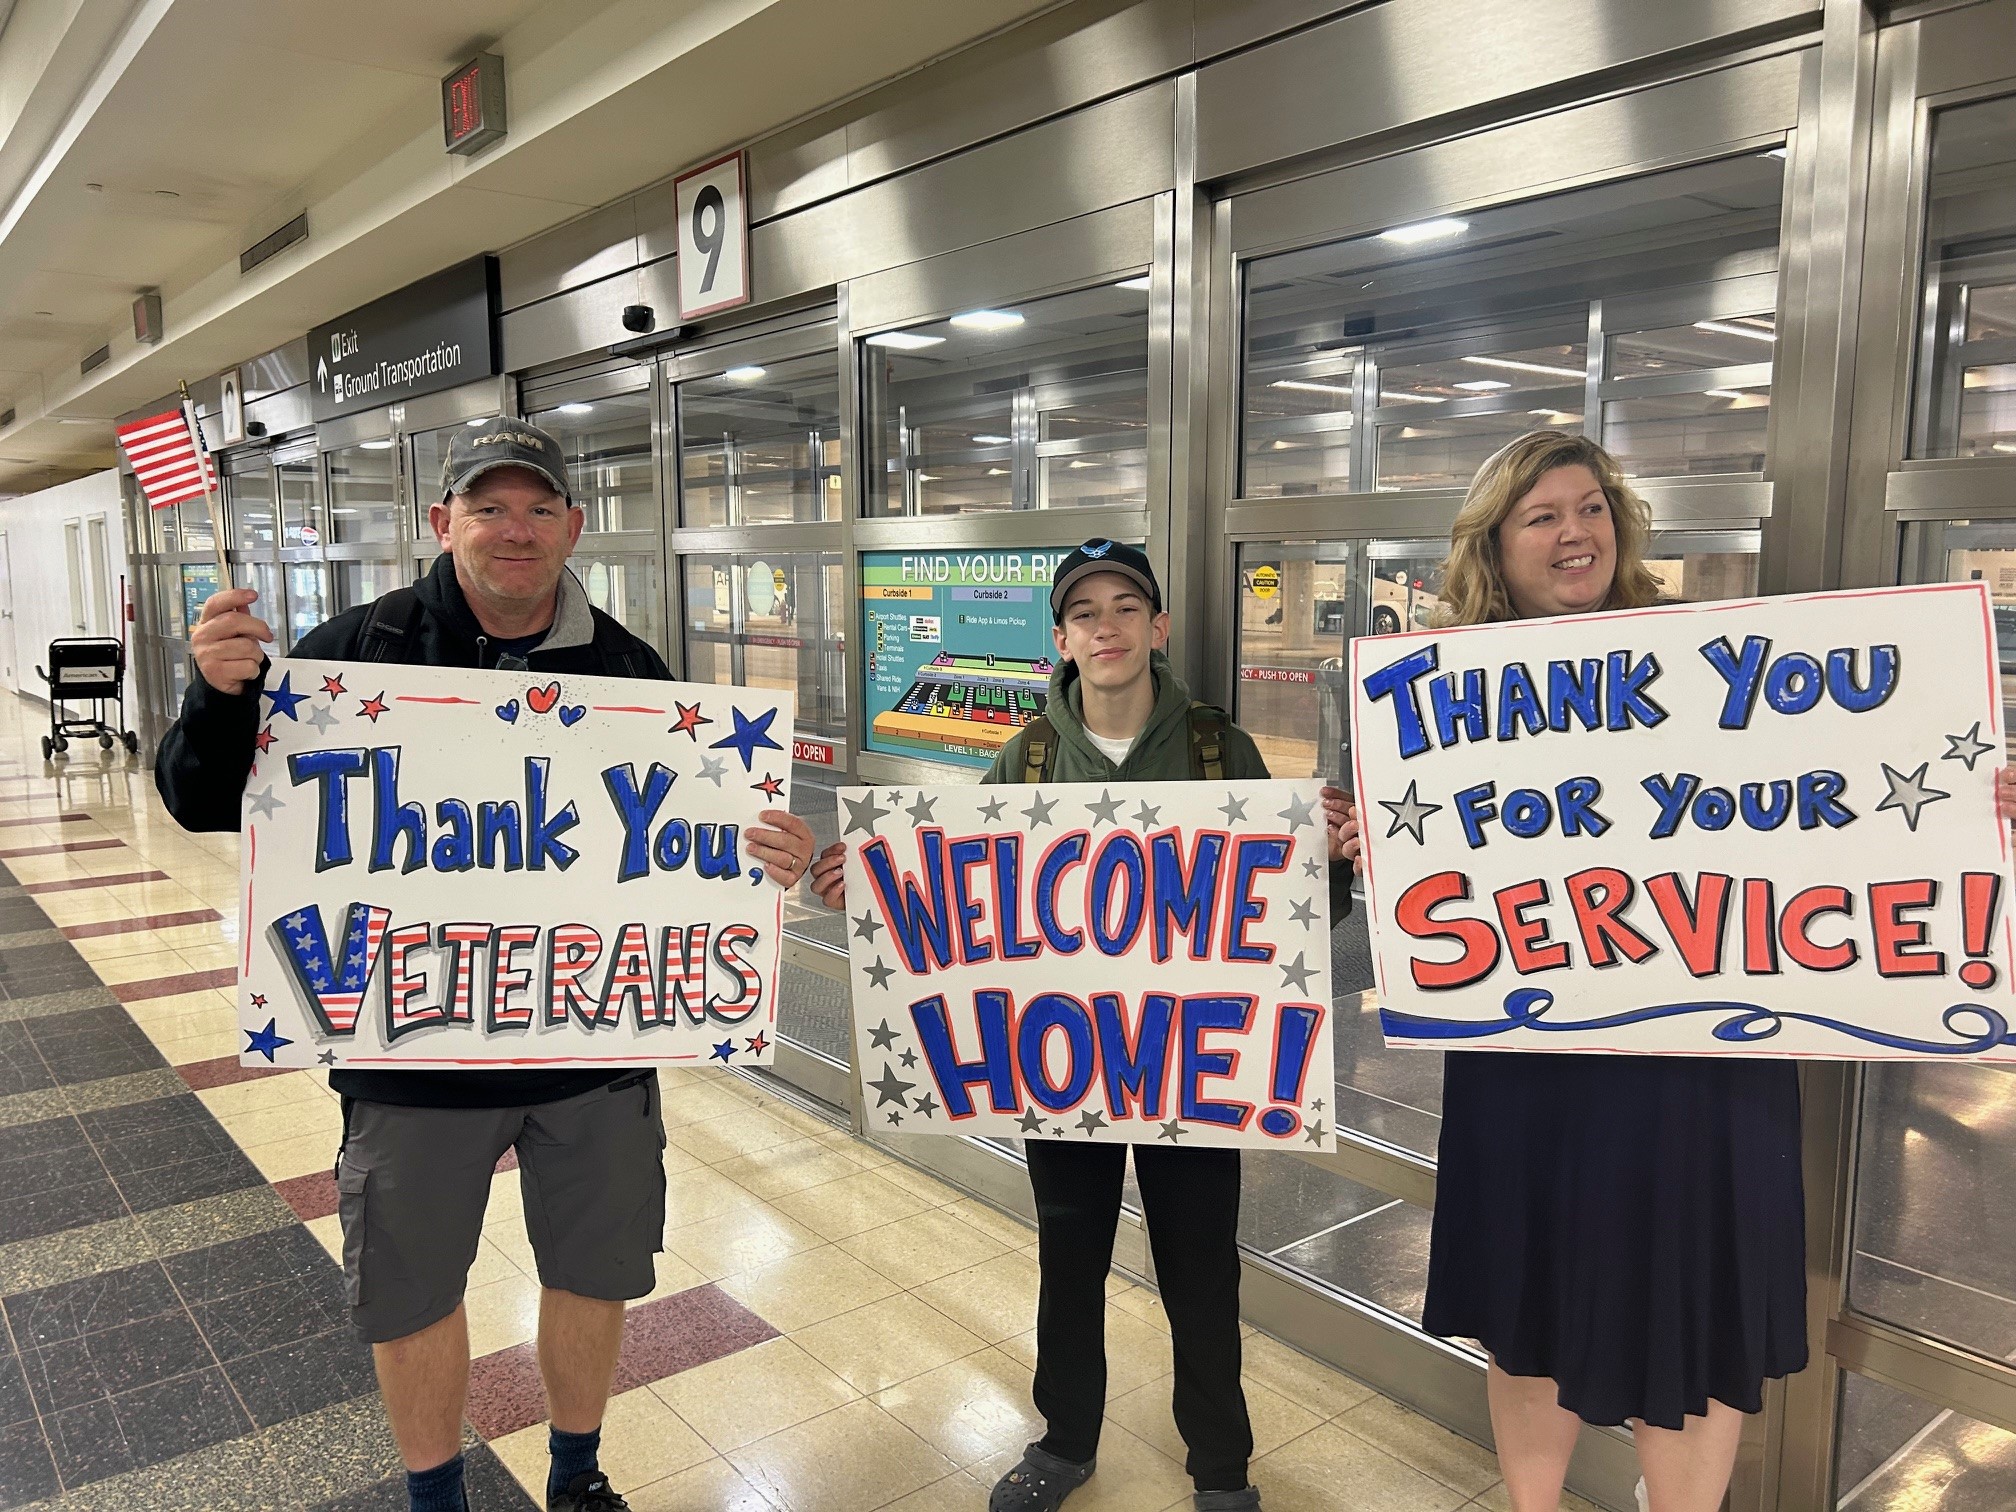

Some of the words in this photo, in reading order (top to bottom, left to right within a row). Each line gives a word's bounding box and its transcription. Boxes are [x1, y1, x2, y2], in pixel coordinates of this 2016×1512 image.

[692, 184, 726, 294] 9
[341, 329, 359, 358] Exit
[344, 363, 380, 398] Ground
[381, 341, 461, 387] Transportation
[473, 431, 544, 450] RAM
[902, 555, 950, 582] FIND
[956, 554, 1023, 583] YOUR
[882, 588, 908, 598] Curbside
[908, 589, 912, 598] 1
[973, 589, 1002, 599] Curbside
[1003, 590, 1008, 599] 2
[966, 615, 977, 624] Ride
[978, 616, 988, 625] App
[1008, 617, 1027, 627] Pickup
[883, 633, 900, 643] Parking
[1258, 670, 1277, 680] PUSH
[1277, 670, 1288, 681] TO
[1288, 672, 1309, 682] OPEN
[1361, 642, 1669, 760] THANK
[1699, 634, 1900, 730] YOU
[803, 744, 826, 762] OPEN
[944, 743, 968, 755] LEVEL
[968, 746, 974, 756] 1
[287, 745, 581, 874] Thank
[601, 762, 765, 887] You,
[1453, 776, 1613, 849] FOR
[1640, 769, 1858, 839] YOUR
[859, 826, 1296, 975] WELCOME
[1393, 866, 2001, 992] SERVICE!
[269, 902, 764, 1046] VETERANS
[908, 988, 1326, 1139] HOME!
